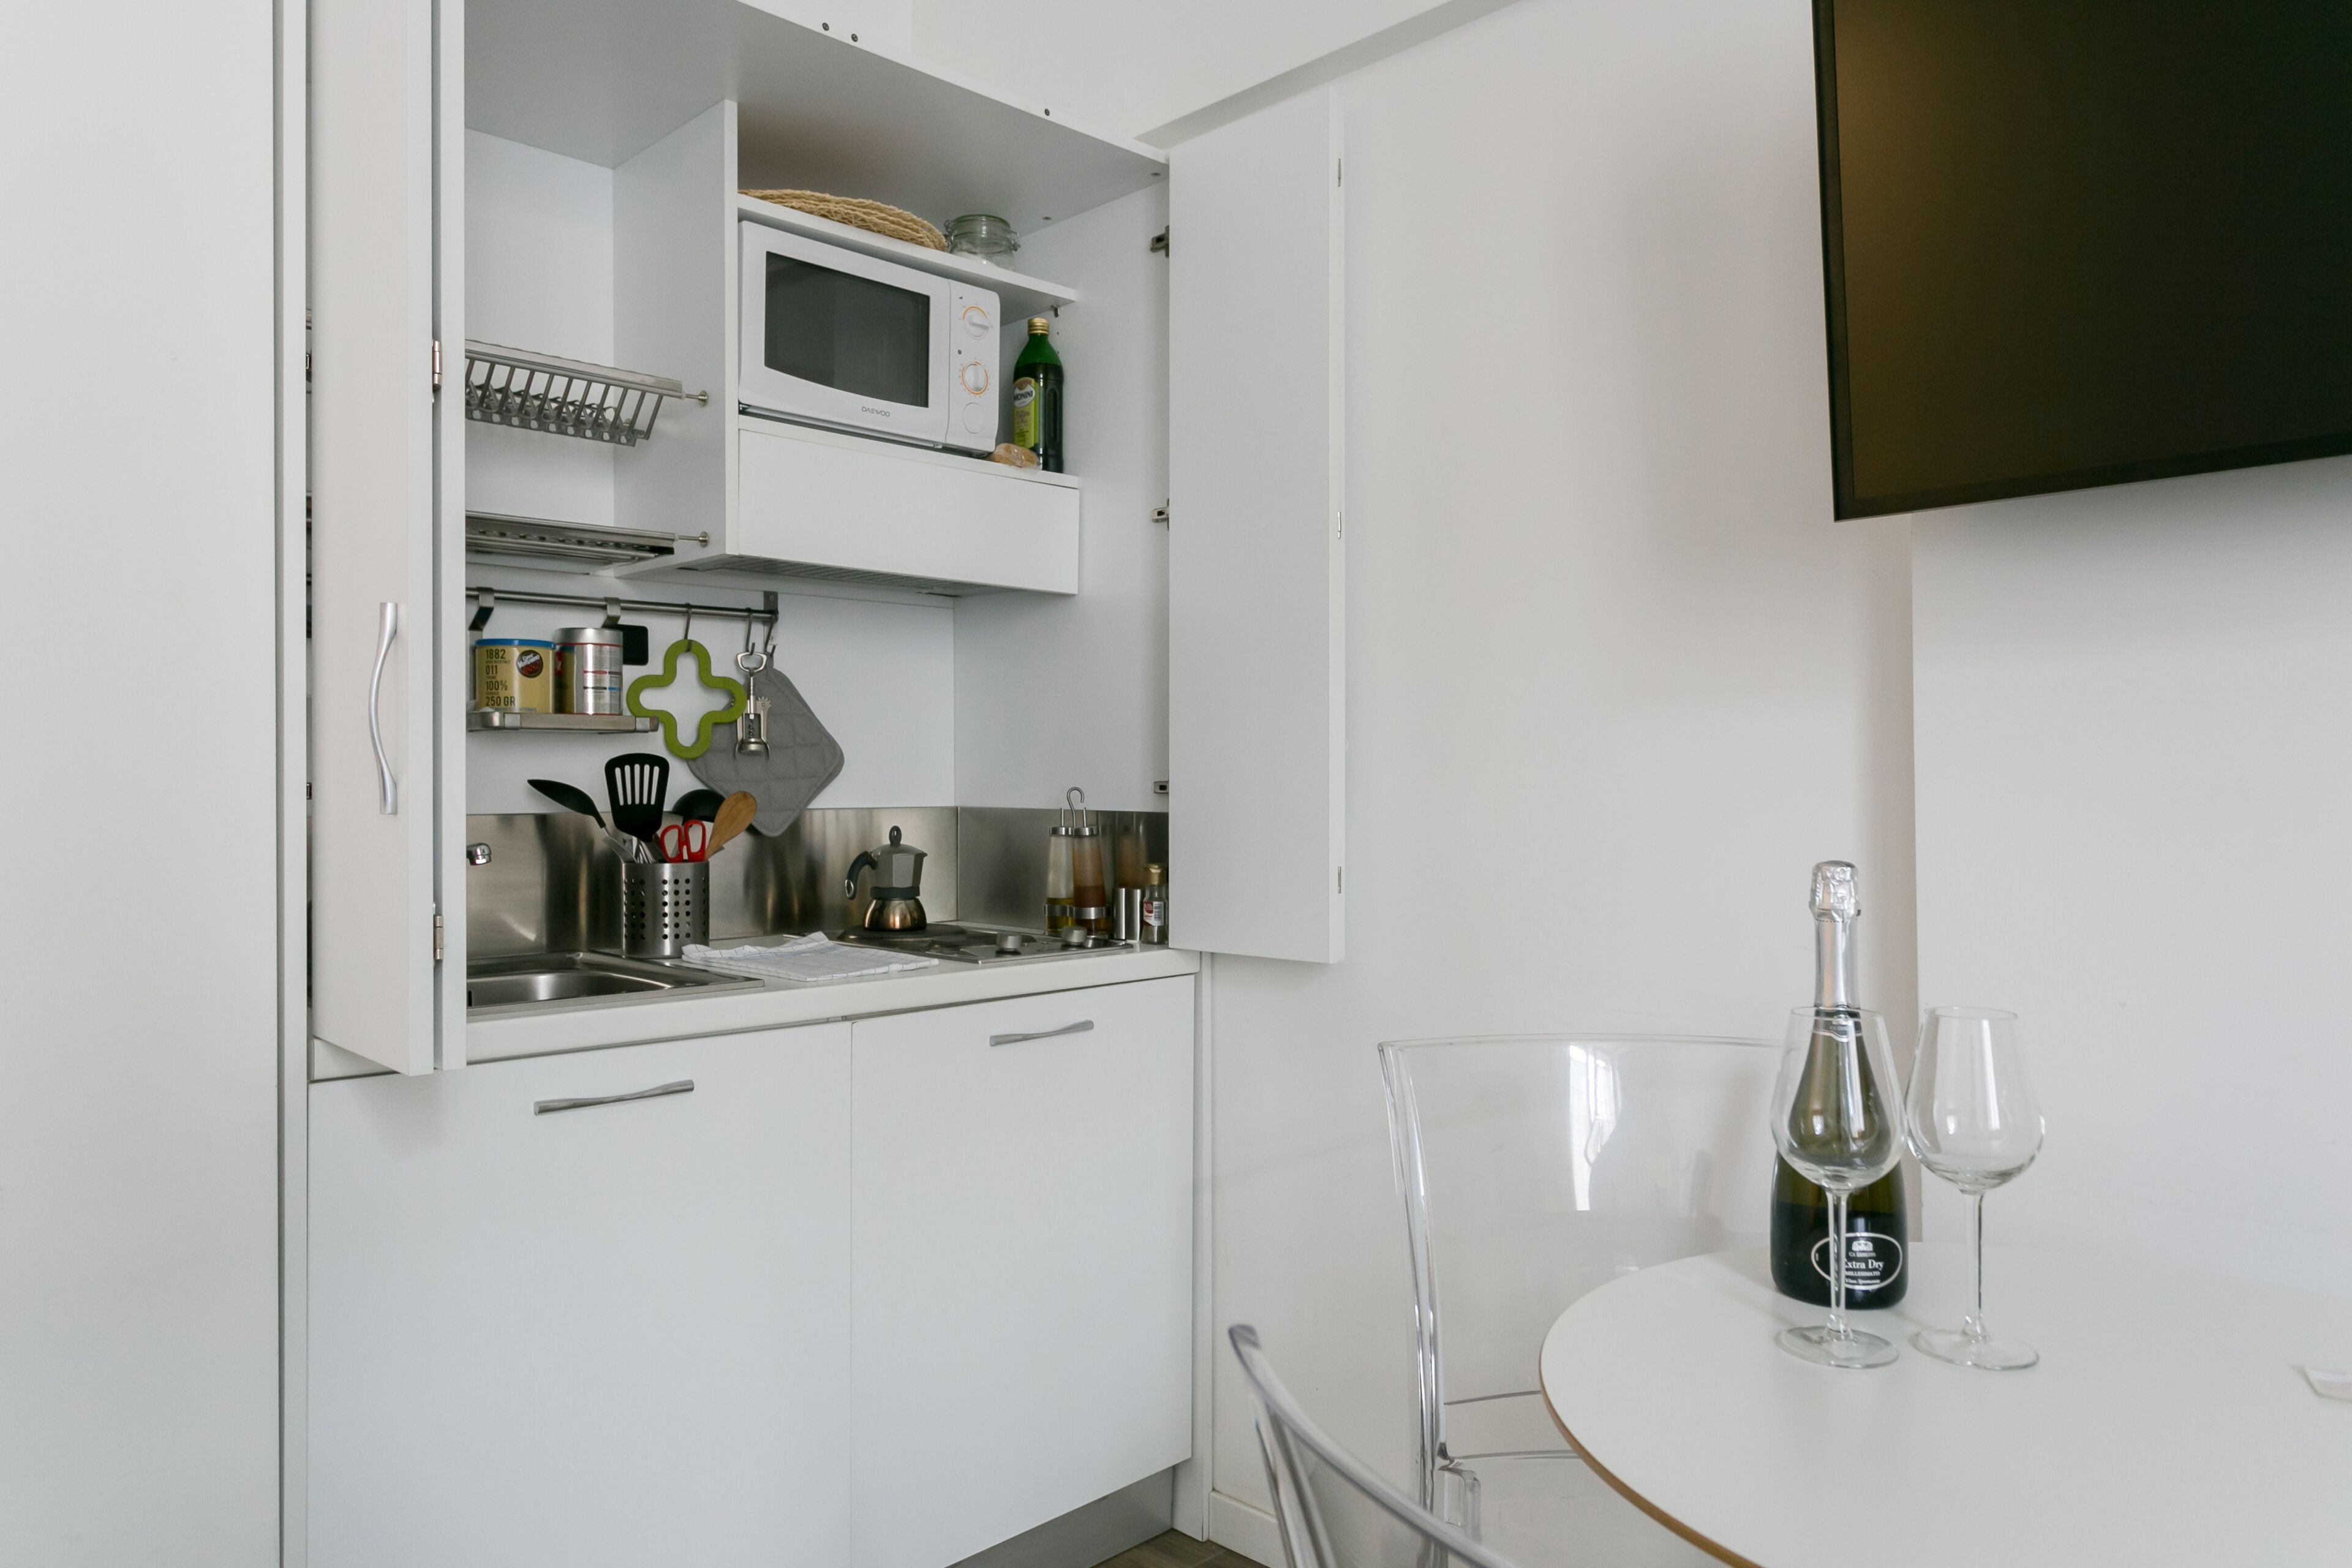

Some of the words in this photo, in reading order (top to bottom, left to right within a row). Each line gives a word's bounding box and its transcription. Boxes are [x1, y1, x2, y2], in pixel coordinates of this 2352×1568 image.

[862, 407, 890, 417] DAEWOO
[486, 649, 506, 660] 1882
[486, 665, 498, 676] 011
[486, 680, 508, 691] 100%
[486, 696, 501, 706] 250
[503, 696, 516, 706] GR
[1868, 1259, 1884, 1271] Dry
